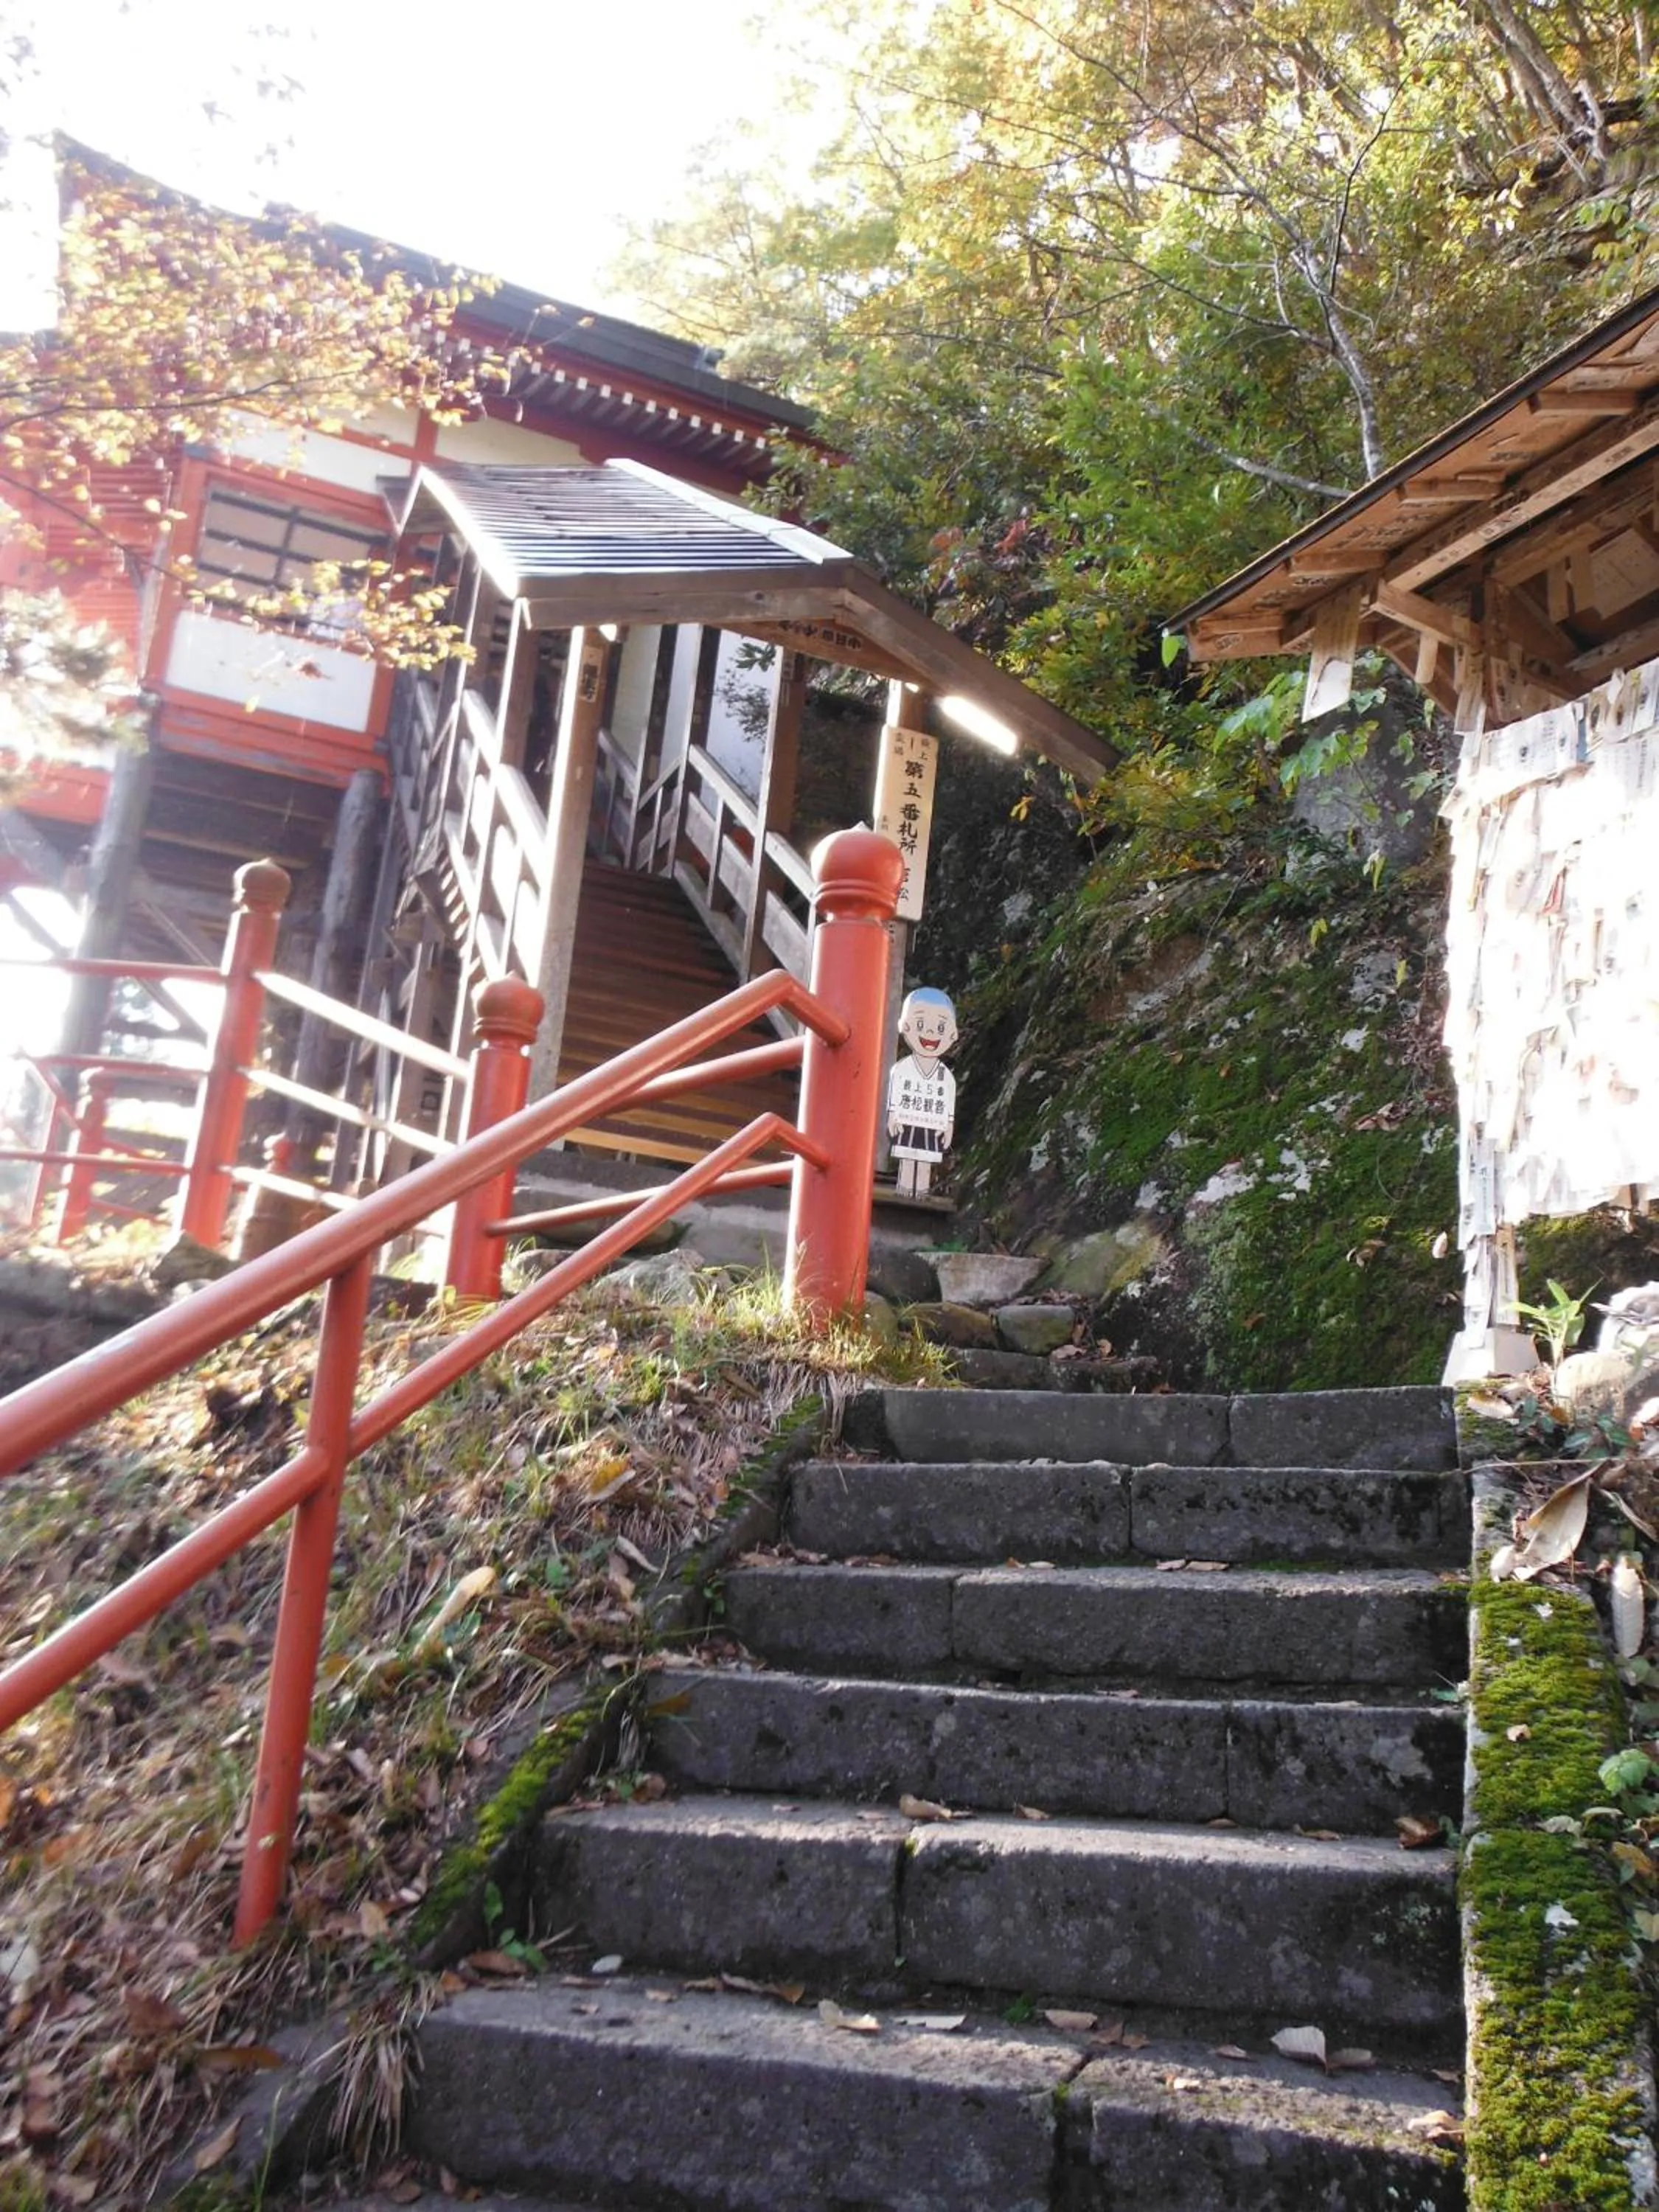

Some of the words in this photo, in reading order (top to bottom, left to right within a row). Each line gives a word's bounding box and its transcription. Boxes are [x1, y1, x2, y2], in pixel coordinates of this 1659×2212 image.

[897, 760, 925, 855] 第五番札所
[900, 1093, 945, 1114] 唐松観音
